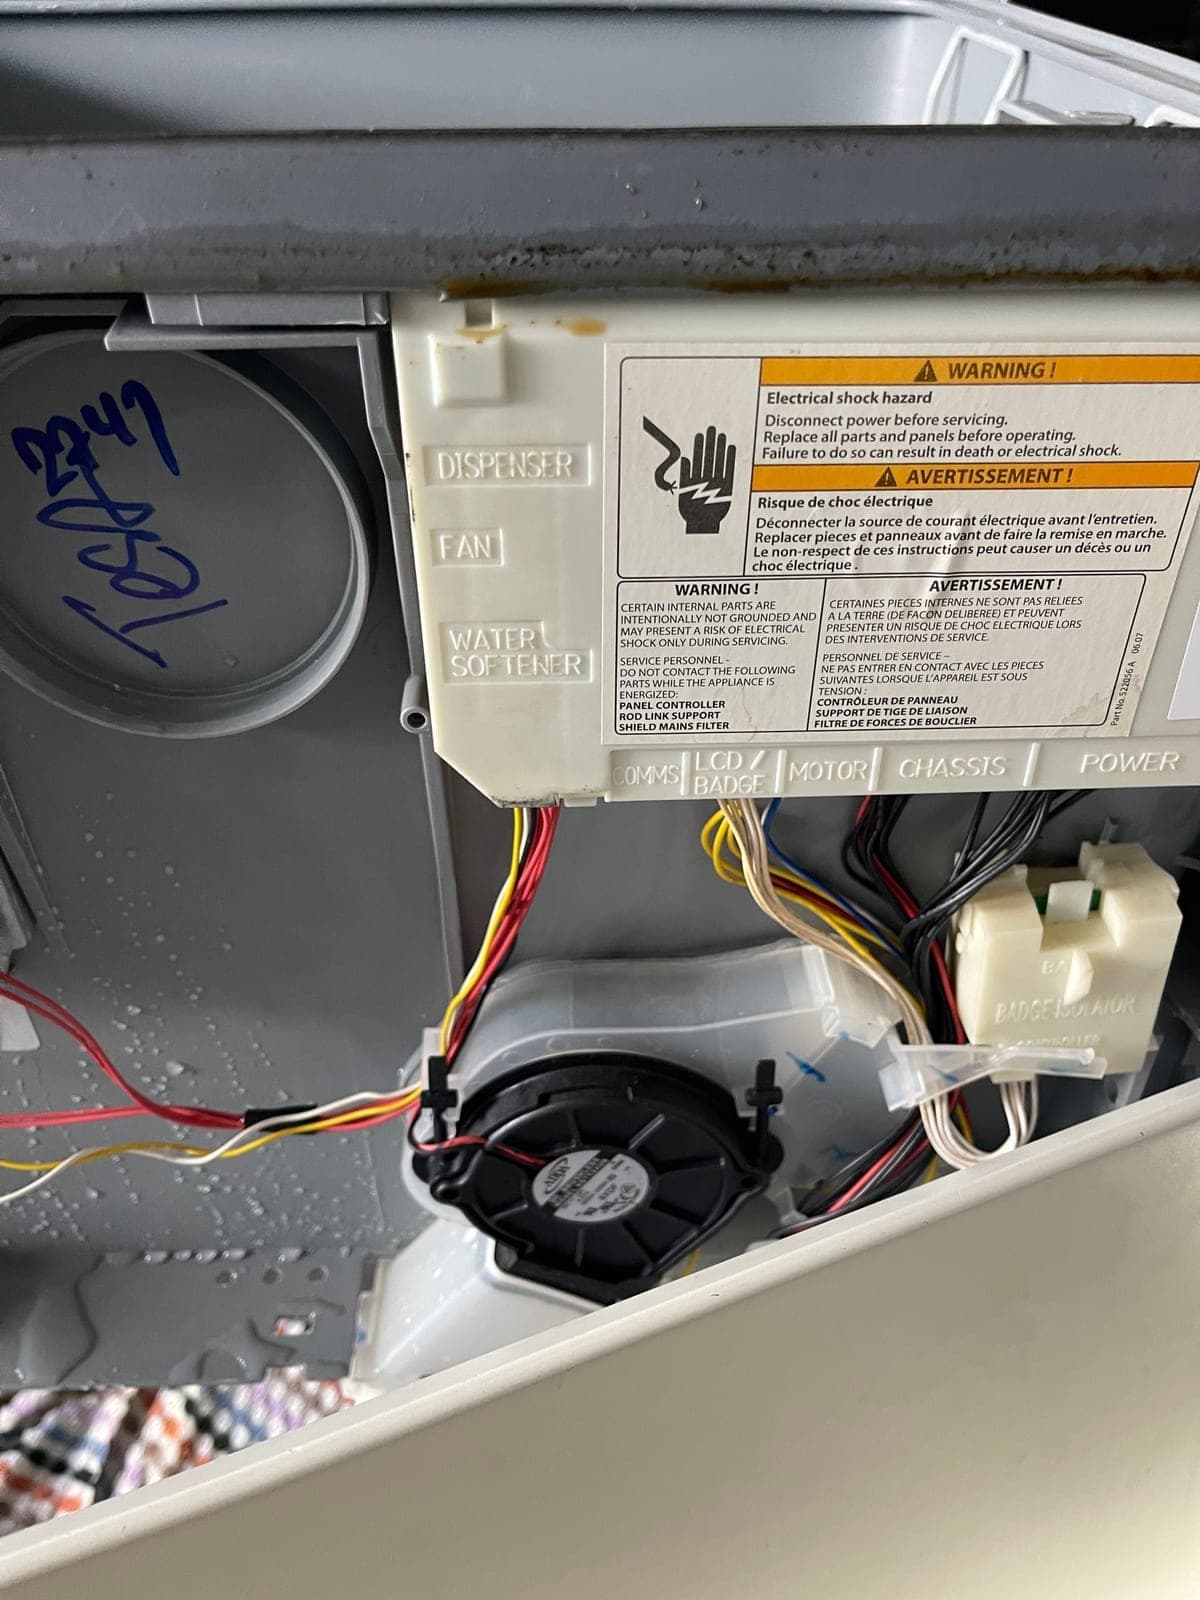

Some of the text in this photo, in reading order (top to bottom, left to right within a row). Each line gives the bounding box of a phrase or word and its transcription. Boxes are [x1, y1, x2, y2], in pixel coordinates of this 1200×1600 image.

[948, 361, 1045, 379] WARNING
[766, 390, 933, 404] Electrical shock hazard
[764, 412, 1008, 429] Disconnect power before servicing.
[763, 428, 1075, 446] Replace all parts and panels before operating.
[761, 443, 1121, 459] Failure to do so can result in death or electrical shock.
[437, 451, 573, 480] DISPENSER
[905, 467, 1064, 484] AVERTISSEMENT
[757, 494, 933, 511] Risque choc électrique
[755, 516, 842, 528] Déconnecter
[858, 517, 903, 527] source
[924, 515, 976, 527] courant
[978, 513, 1045, 528] électrique
[1047, 514, 1086, 525] avant
[754, 526, 1166, 546] Replacer pieces panneaux avant faire remise marche.
[439, 534, 490, 560] FAN
[771, 541, 1112, 559] non-respect ces instructions peut causer décès
[751, 559, 783, 572] choc
[674, 582, 750, 596] WARNING
[928, 578, 1055, 592] AVERTISSEMENT
[620, 600, 776, 612] CERTAIN INTERNAL PARTS ARE
[828, 595, 1083, 609] CERTAINES PIECES INTERNES SONT PAS RELIEES
[620, 611, 817, 624] INTENTIONALLY NOT GROUNDED AND
[853, 610, 885, 620] TERRE
[886, 610, 905, 620] (DE
[943, 608, 1001, 619] DELIBEREE)
[1016, 607, 1066, 618] PEUVENT
[619, 623, 805, 636] MAY PRESENT RISK ELECTRICAL
[825, 619, 1082, 632] PRESENTER RISQUE CHOC ELECTRIQUE LORS
[448, 628, 535, 651] WATER
[619, 635, 788, 648] SHOCK ONLY DURING SERVICING.
[824, 631, 991, 644] DES INTERVENTIONS SERVICE.
[619, 655, 723, 666] SERVICE PERSONNEL
[821, 650, 942, 662] PERSONNEL SERVICE
[451, 653, 582, 677] SOFTENER
[638, 664, 795, 677] NOT CONTACT THE FOLLOWING
[836, 660, 1044, 673] PAS ENTRER CONTACT AVEC LES PIECES
[619, 676, 764, 688] PARTS WHILE THE APPLIANCE
[818, 674, 874, 685] SUIVANTES
[875, 673, 923, 684] LORSQUE
[980, 672, 1000, 682] EST
[999, 671, 1028, 681] SOUS
[619, 689, 678, 699] ENERGIZED:
[817, 686, 862, 696] TENSION
[618, 699, 725, 710] PANEL CONTROLLER
[816, 695, 888, 706] CONTRÔLEUR
[618, 710, 721, 721] ROD LINK SUPPORT
[814, 705, 968, 717] SUPPORT TIGE LIAISON
[618, 721, 729, 731] SHIELD MAINS FILTER
[813, 716, 977, 728] FILTRE FORCES BOUCLIER
[1109, 711, 1122, 727] Part
[898, 755, 1007, 778] CHASSIS
[1079, 751, 1180, 774] POWER
[612, 764, 680, 785] COMMS
[788, 760, 868, 782] MOTOR
[693, 774, 766, 796] BADGE
[995, 999, 1050, 1025] BADGE
